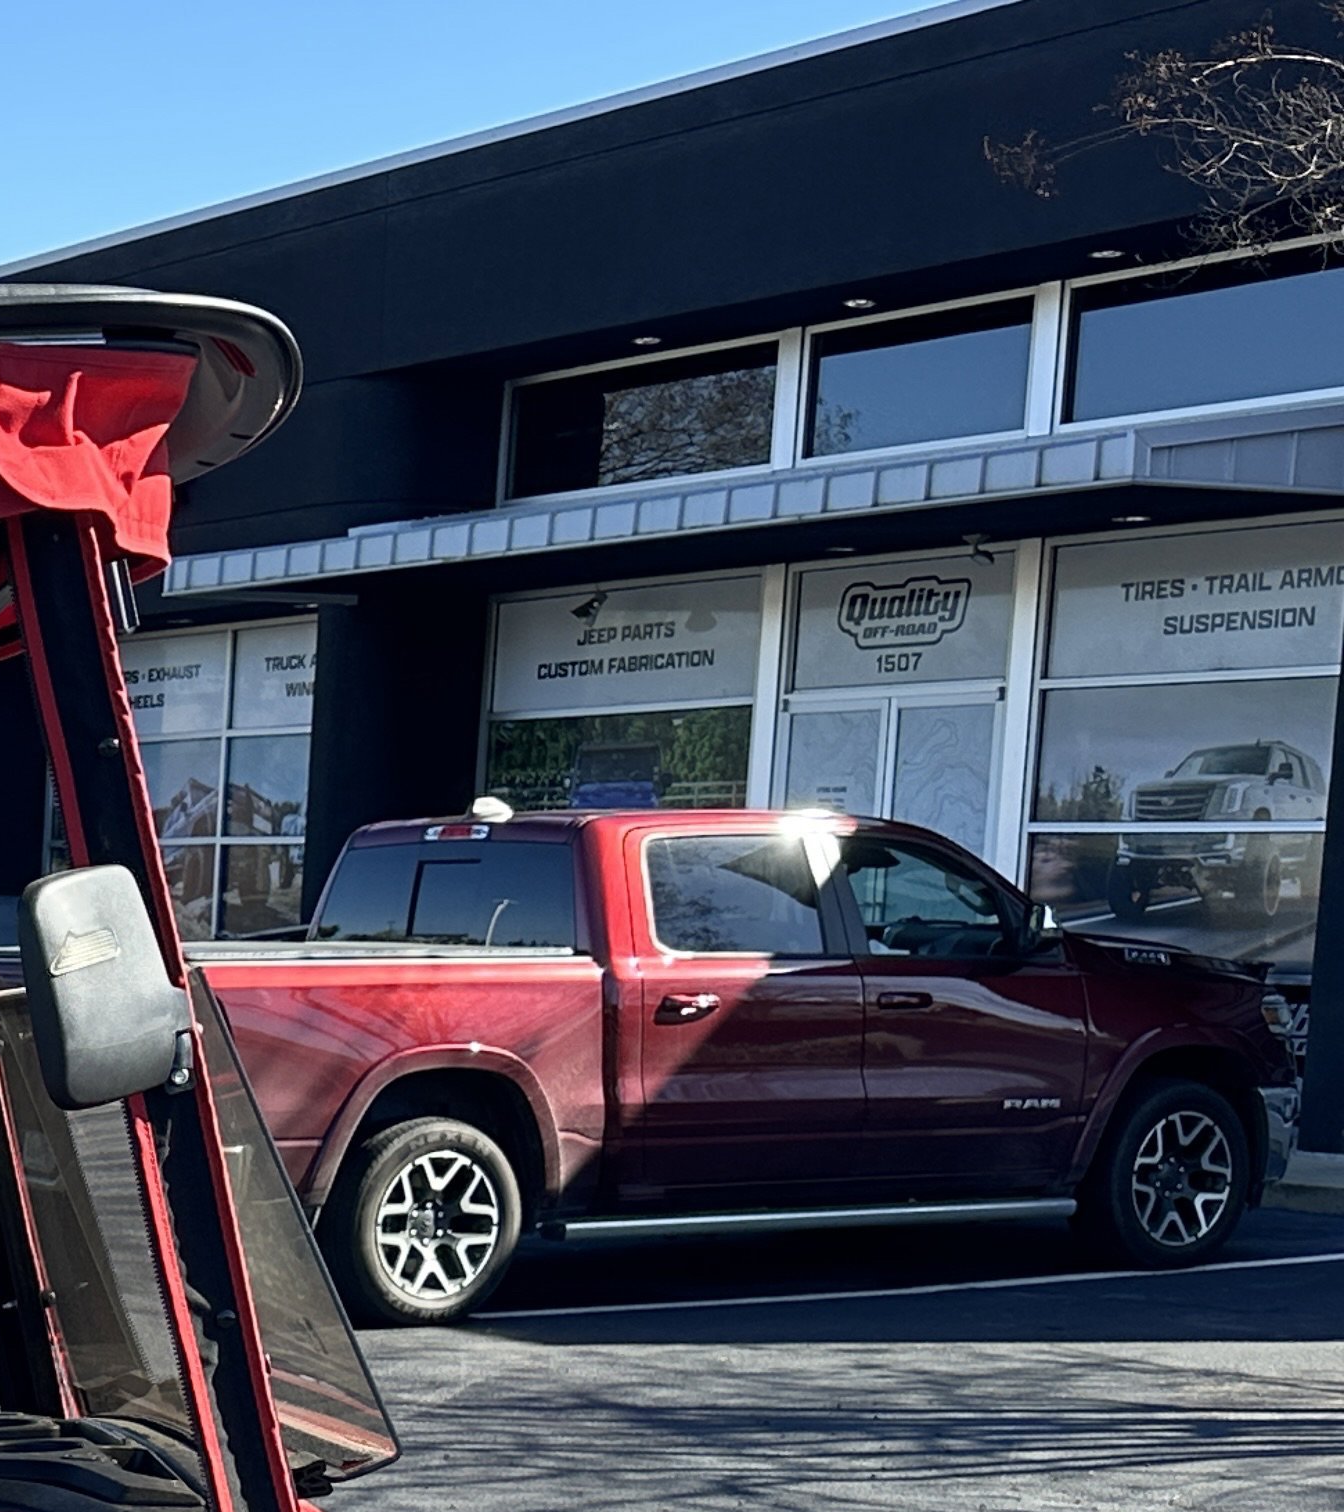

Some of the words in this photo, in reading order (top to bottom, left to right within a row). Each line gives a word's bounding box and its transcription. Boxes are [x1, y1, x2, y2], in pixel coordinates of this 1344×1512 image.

[1121, 577, 1185, 602] TIRES
[1205, 571, 1271, 595] TRAIL
[846, 587, 961, 626] Quality
[863, 621, 938, 639] OFF-ROAD
[1163, 606, 1316, 635] SUSPENSION
[577, 627, 617, 646] JEEP
[621, 621, 675, 642] PARTS
[148, 664, 202, 682] EXHAUST
[264, 654, 307, 672] TRUCK
[537, 658, 604, 680] CUSTOM
[608, 649, 715, 674] FABRICATION
[876, 652, 923, 673] 1507
[1003, 1098, 1061, 1110] RAM
